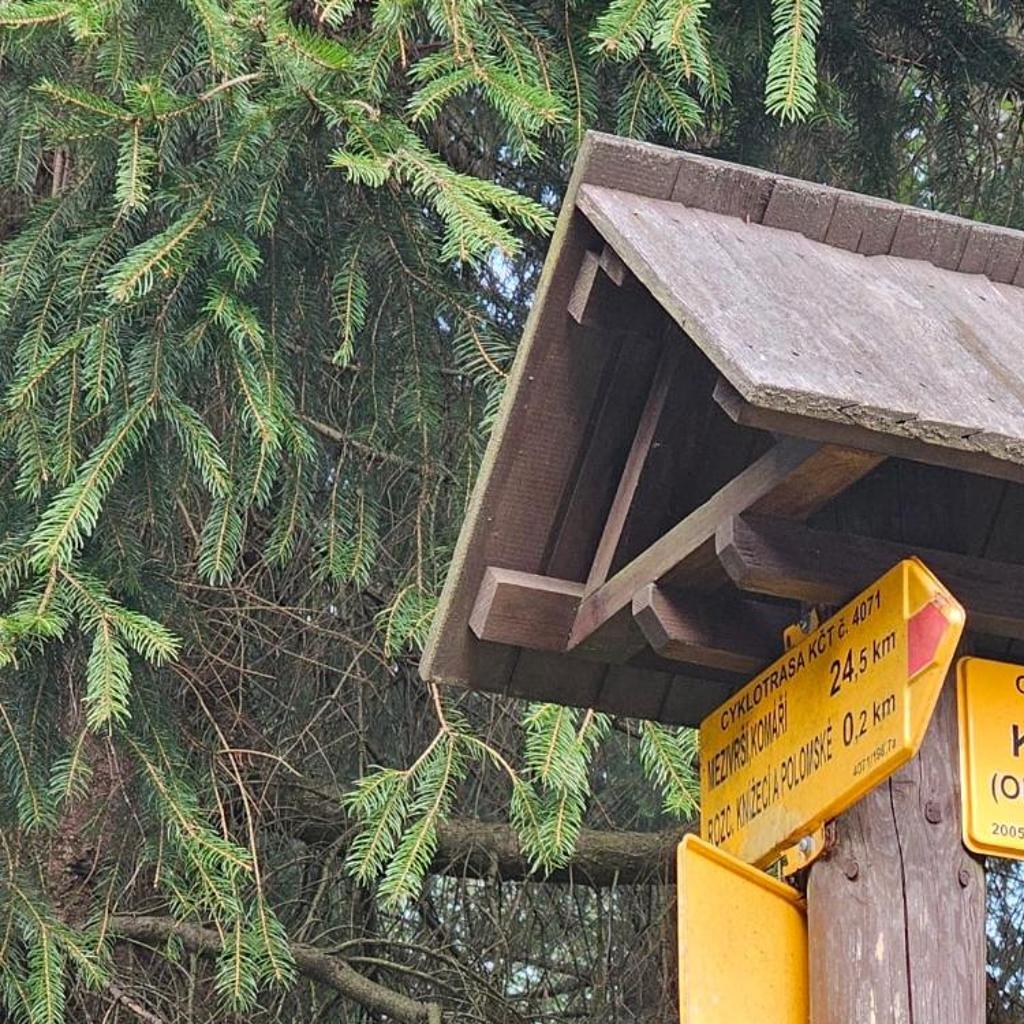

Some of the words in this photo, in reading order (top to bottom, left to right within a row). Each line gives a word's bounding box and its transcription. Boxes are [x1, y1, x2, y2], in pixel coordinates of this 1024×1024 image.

[720, 651, 805, 731] CYKLOTRASA
[808, 626, 834, 663] KČT
[852, 590, 881, 626] 4071
[829, 648, 867, 696] 24,5
[872, 631, 896, 664] km
[773, 768, 780, 802] A
[781, 718, 832, 795] POLOMSKÉ
[843, 709, 867, 746] 0,2
[873, 694, 896, 726] km
